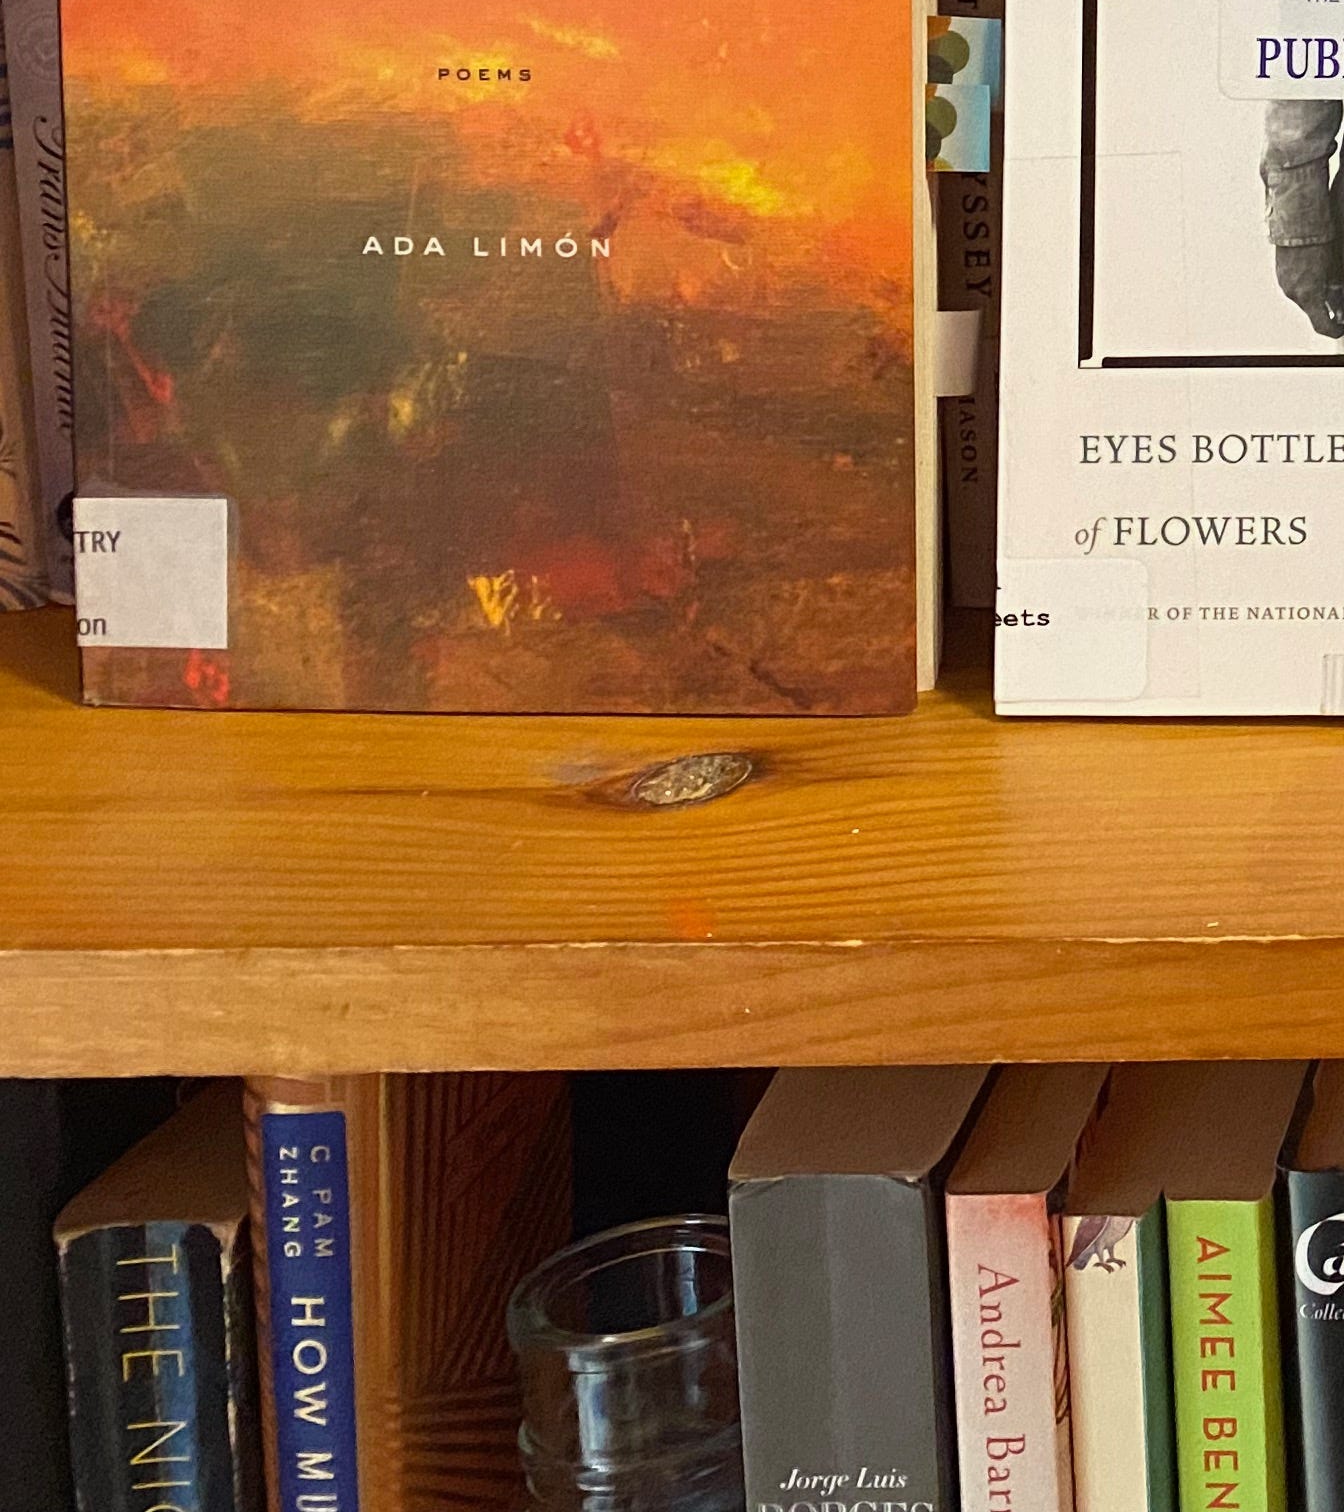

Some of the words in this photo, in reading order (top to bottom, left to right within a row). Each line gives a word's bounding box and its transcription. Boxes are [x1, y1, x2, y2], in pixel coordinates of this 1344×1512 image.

[437, 67, 534, 82] POEMS
[362, 234, 447, 257] ADA
[474, 229, 613, 259] LIMÓN
[1079, 435, 1177, 465] EYES
[1073, 516, 1108, 555] of
[1113, 516, 1307, 547] FLOWERS
[1167, 607, 1193, 621] OF
[1199, 607, 1242, 621] THE
[310, 1145, 331, 1163] C
[279, 1146, 301, 1258] ZHANG
[312, 1189, 336, 1258] PAM
[117, 1244, 184, 1382] THE
[977, 1263, 1021, 1416] Andrea
[1196, 1235, 1236, 1392] AIMEE
[290, 1296, 328, 1426] HOW
[779, 1468, 850, 1497] Jorge
[855, 1467, 908, 1489] Luis
[1202, 1418, 1239, 1510] BEN
